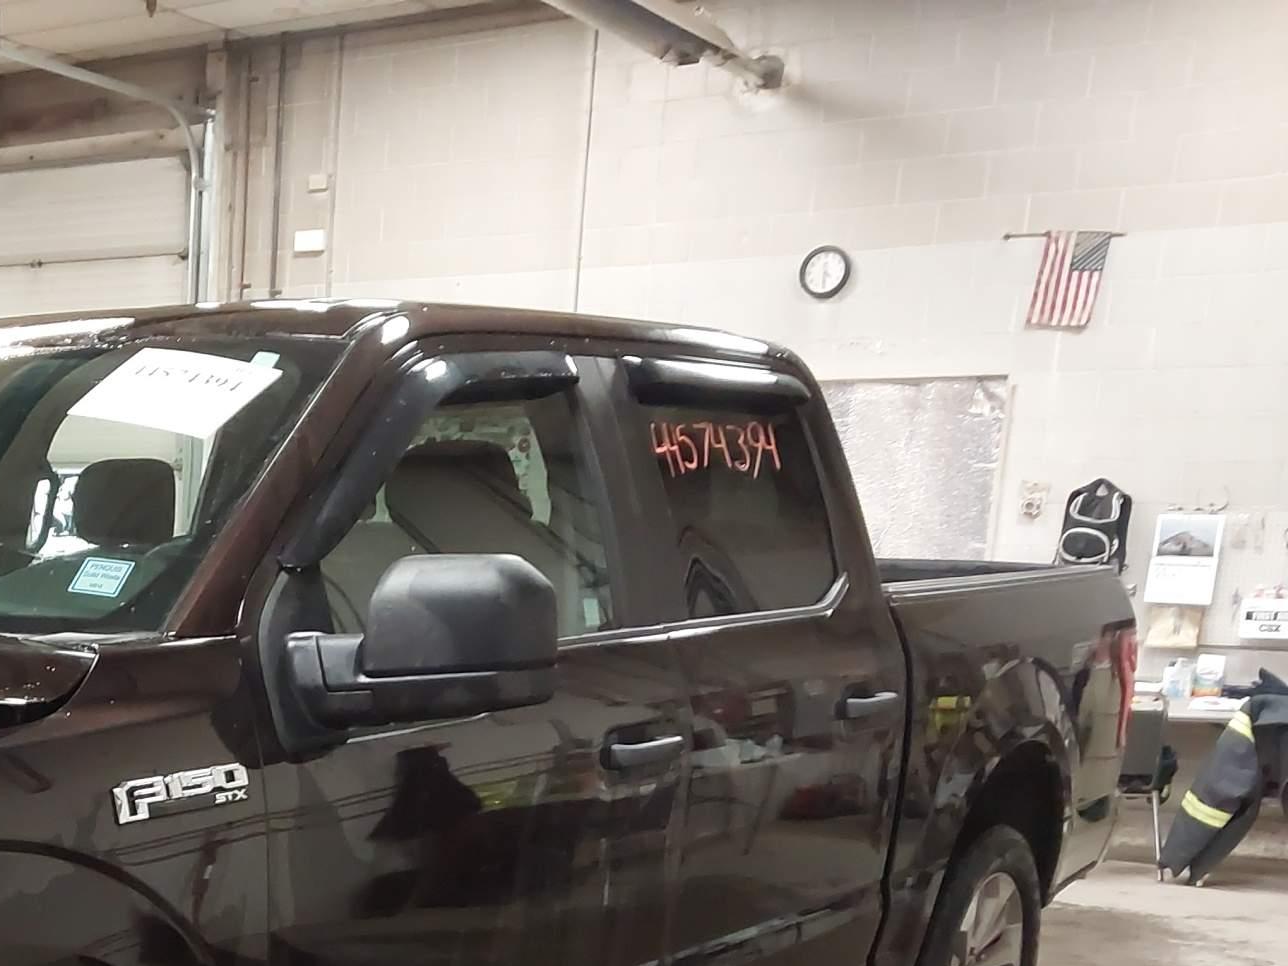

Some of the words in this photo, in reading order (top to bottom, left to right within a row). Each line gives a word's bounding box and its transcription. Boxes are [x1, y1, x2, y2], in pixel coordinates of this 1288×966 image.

[650, 421, 782, 480] 44574394
[112, 762, 249, 825] F150
[214, 788, 248, 805] STX
